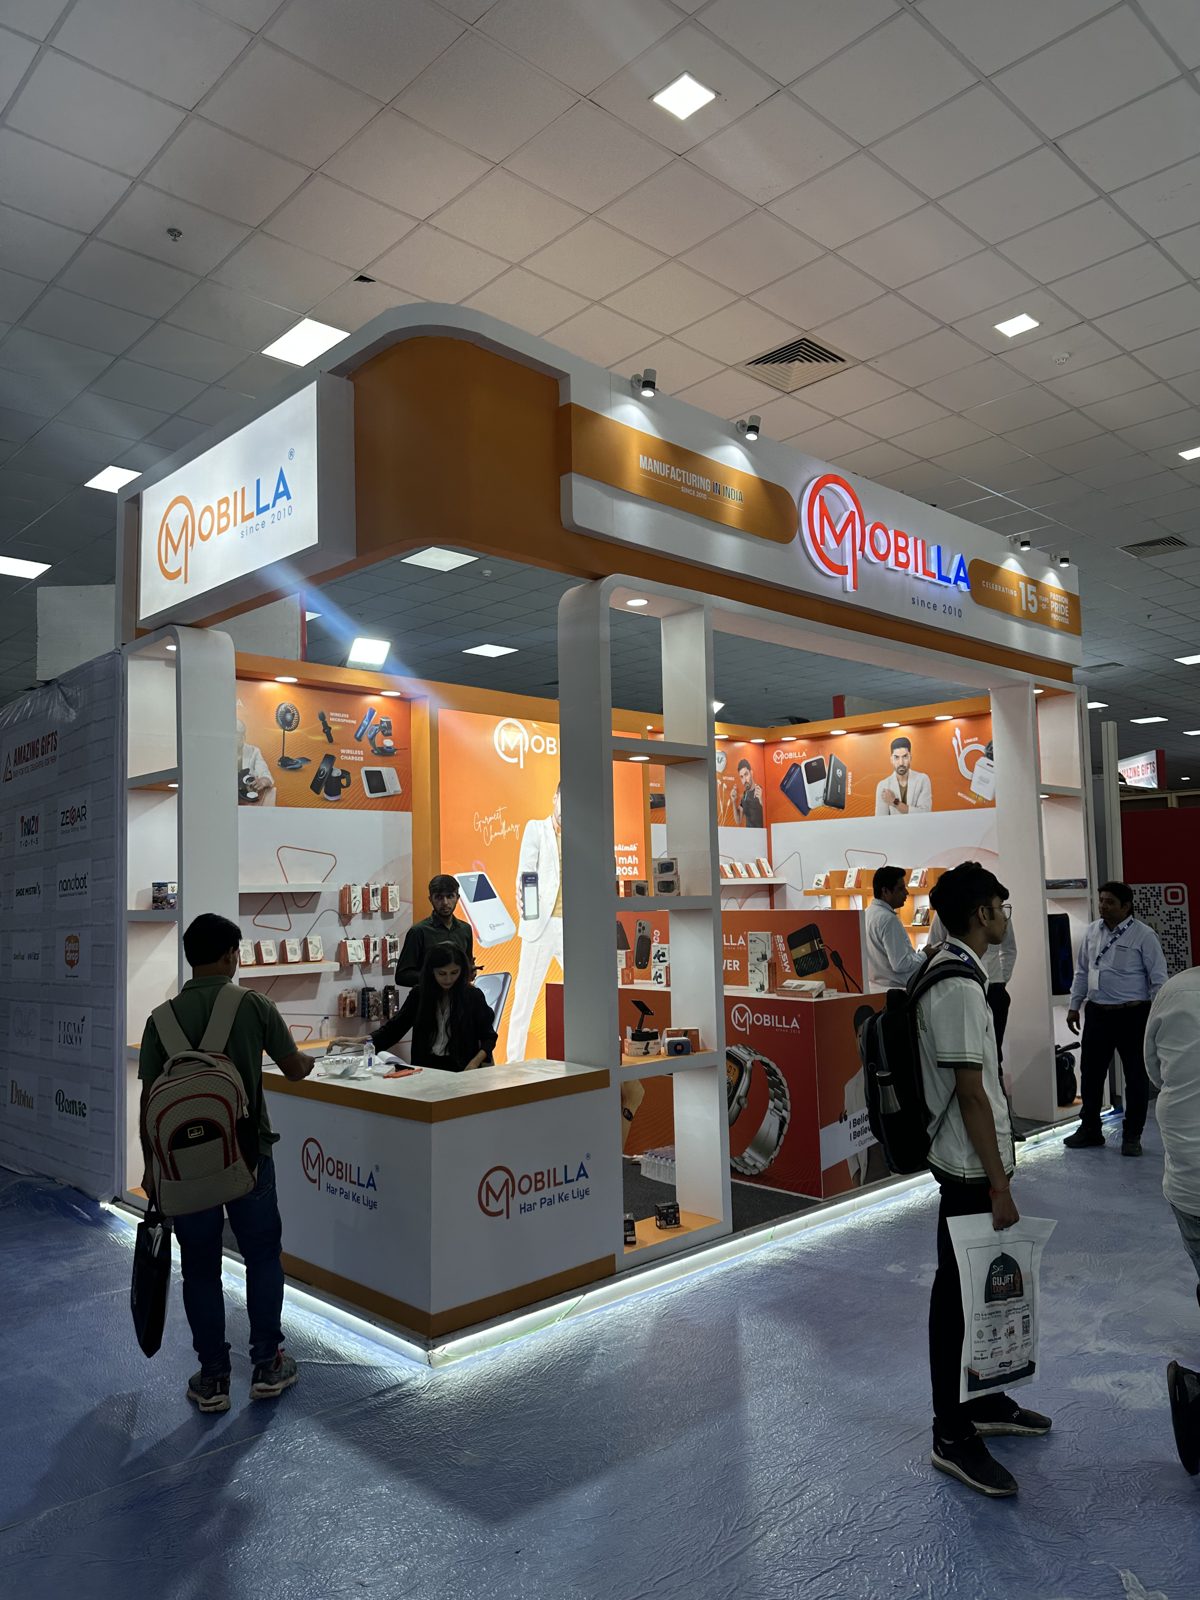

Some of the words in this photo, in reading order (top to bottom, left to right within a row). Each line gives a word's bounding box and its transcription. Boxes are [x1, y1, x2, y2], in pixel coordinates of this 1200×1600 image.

[639, 454, 711, 492] MANUFACTURING
[712, 481, 721, 497] IN
[722, 484, 744, 504] INDIA
[157, 466, 292, 584] MOBILLA
[240, 520, 266, 539] since
[271, 505, 293, 526] 2010
[800, 473, 970, 592] MOBILLA
[982, 580, 1017, 597] CELEBRATING
[1018, 581, 1038, 614] 15
[911, 595, 937, 611] since
[942, 605, 963, 619] 2010
[1050, 601, 1069, 617] PRIDE
[13, 737, 40, 767] AMAZING
[41, 729, 58, 756] GIFTS
[340, 748, 364, 756] WIRELESS
[773, 749, 807, 766] MOBILLA
[1141, 760, 1155, 776] GIFTS
[731, 1003, 800, 1036] MOBILLA
[301, 1137, 377, 1192] MOBILLA
[326, 1182, 338, 1196] Har
[339, 1187, 351, 1201] Pal
[351, 1191, 361, 1205] Ke
[362, 1195, 378, 1210] Liye
[478, 1162, 589, 1220] MOBILLA
[519, 1201, 537, 1215] Har
[539, 1194, 556, 1209] Pal
[558, 1191, 570, 1204] Ke
[571, 1186, 591, 1201] Liye
